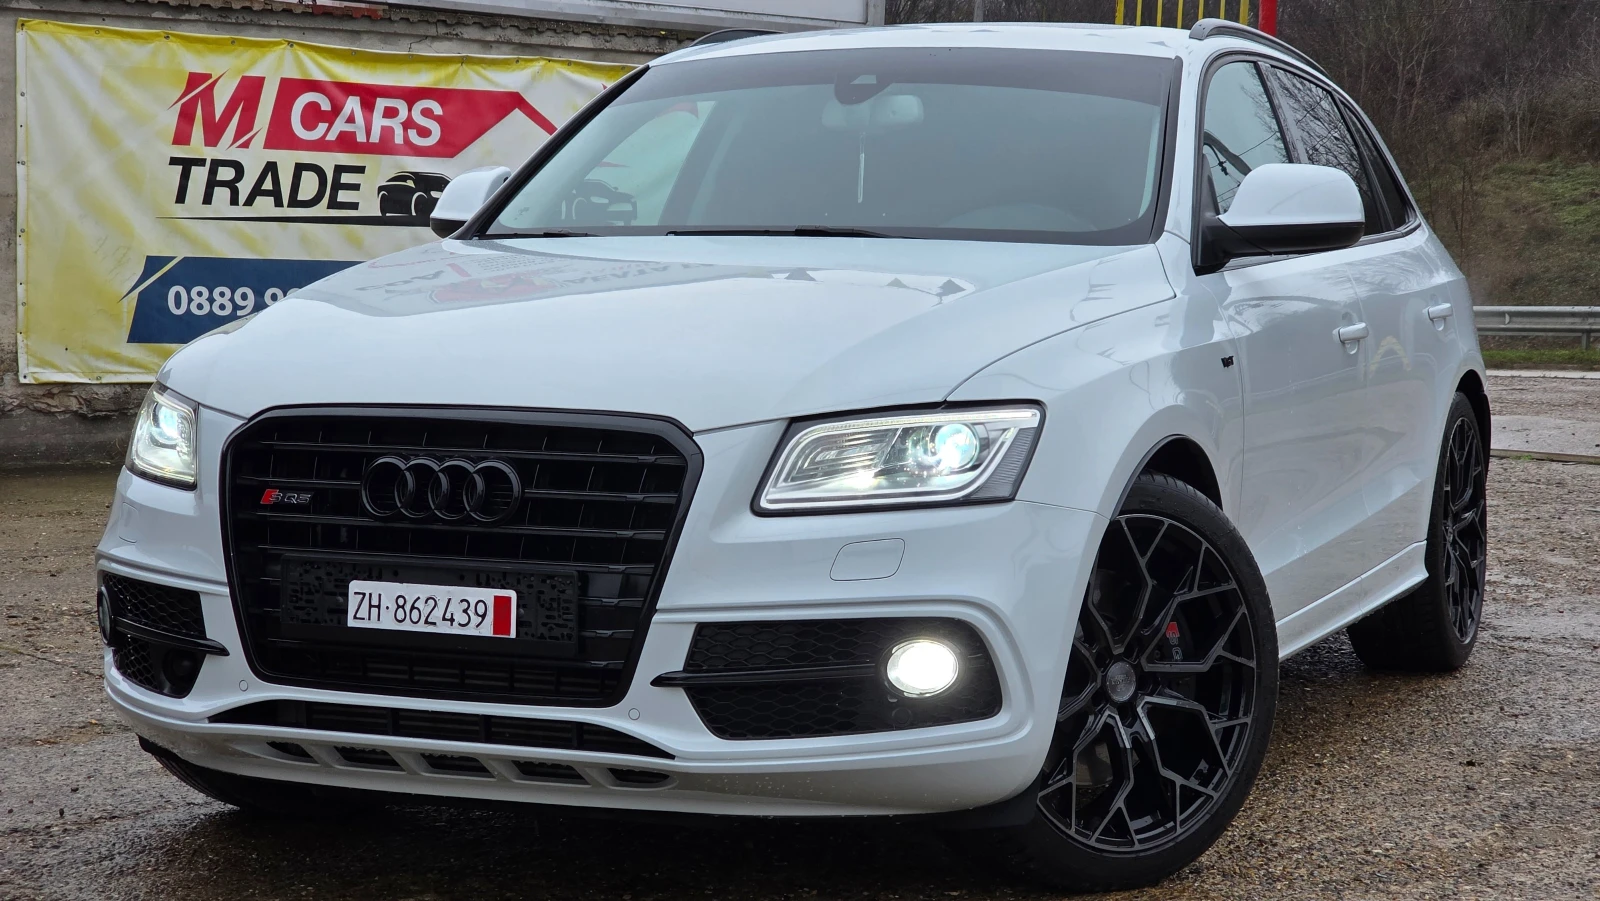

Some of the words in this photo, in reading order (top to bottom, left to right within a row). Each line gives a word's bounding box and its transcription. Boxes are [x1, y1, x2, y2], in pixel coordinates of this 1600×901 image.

[167, 69, 266, 150] M
[291, 92, 443, 146] CARS
[168, 156, 366, 211] TRADE
[167, 285, 255, 316] 0889
[266, 490, 311, 504] SQ5
